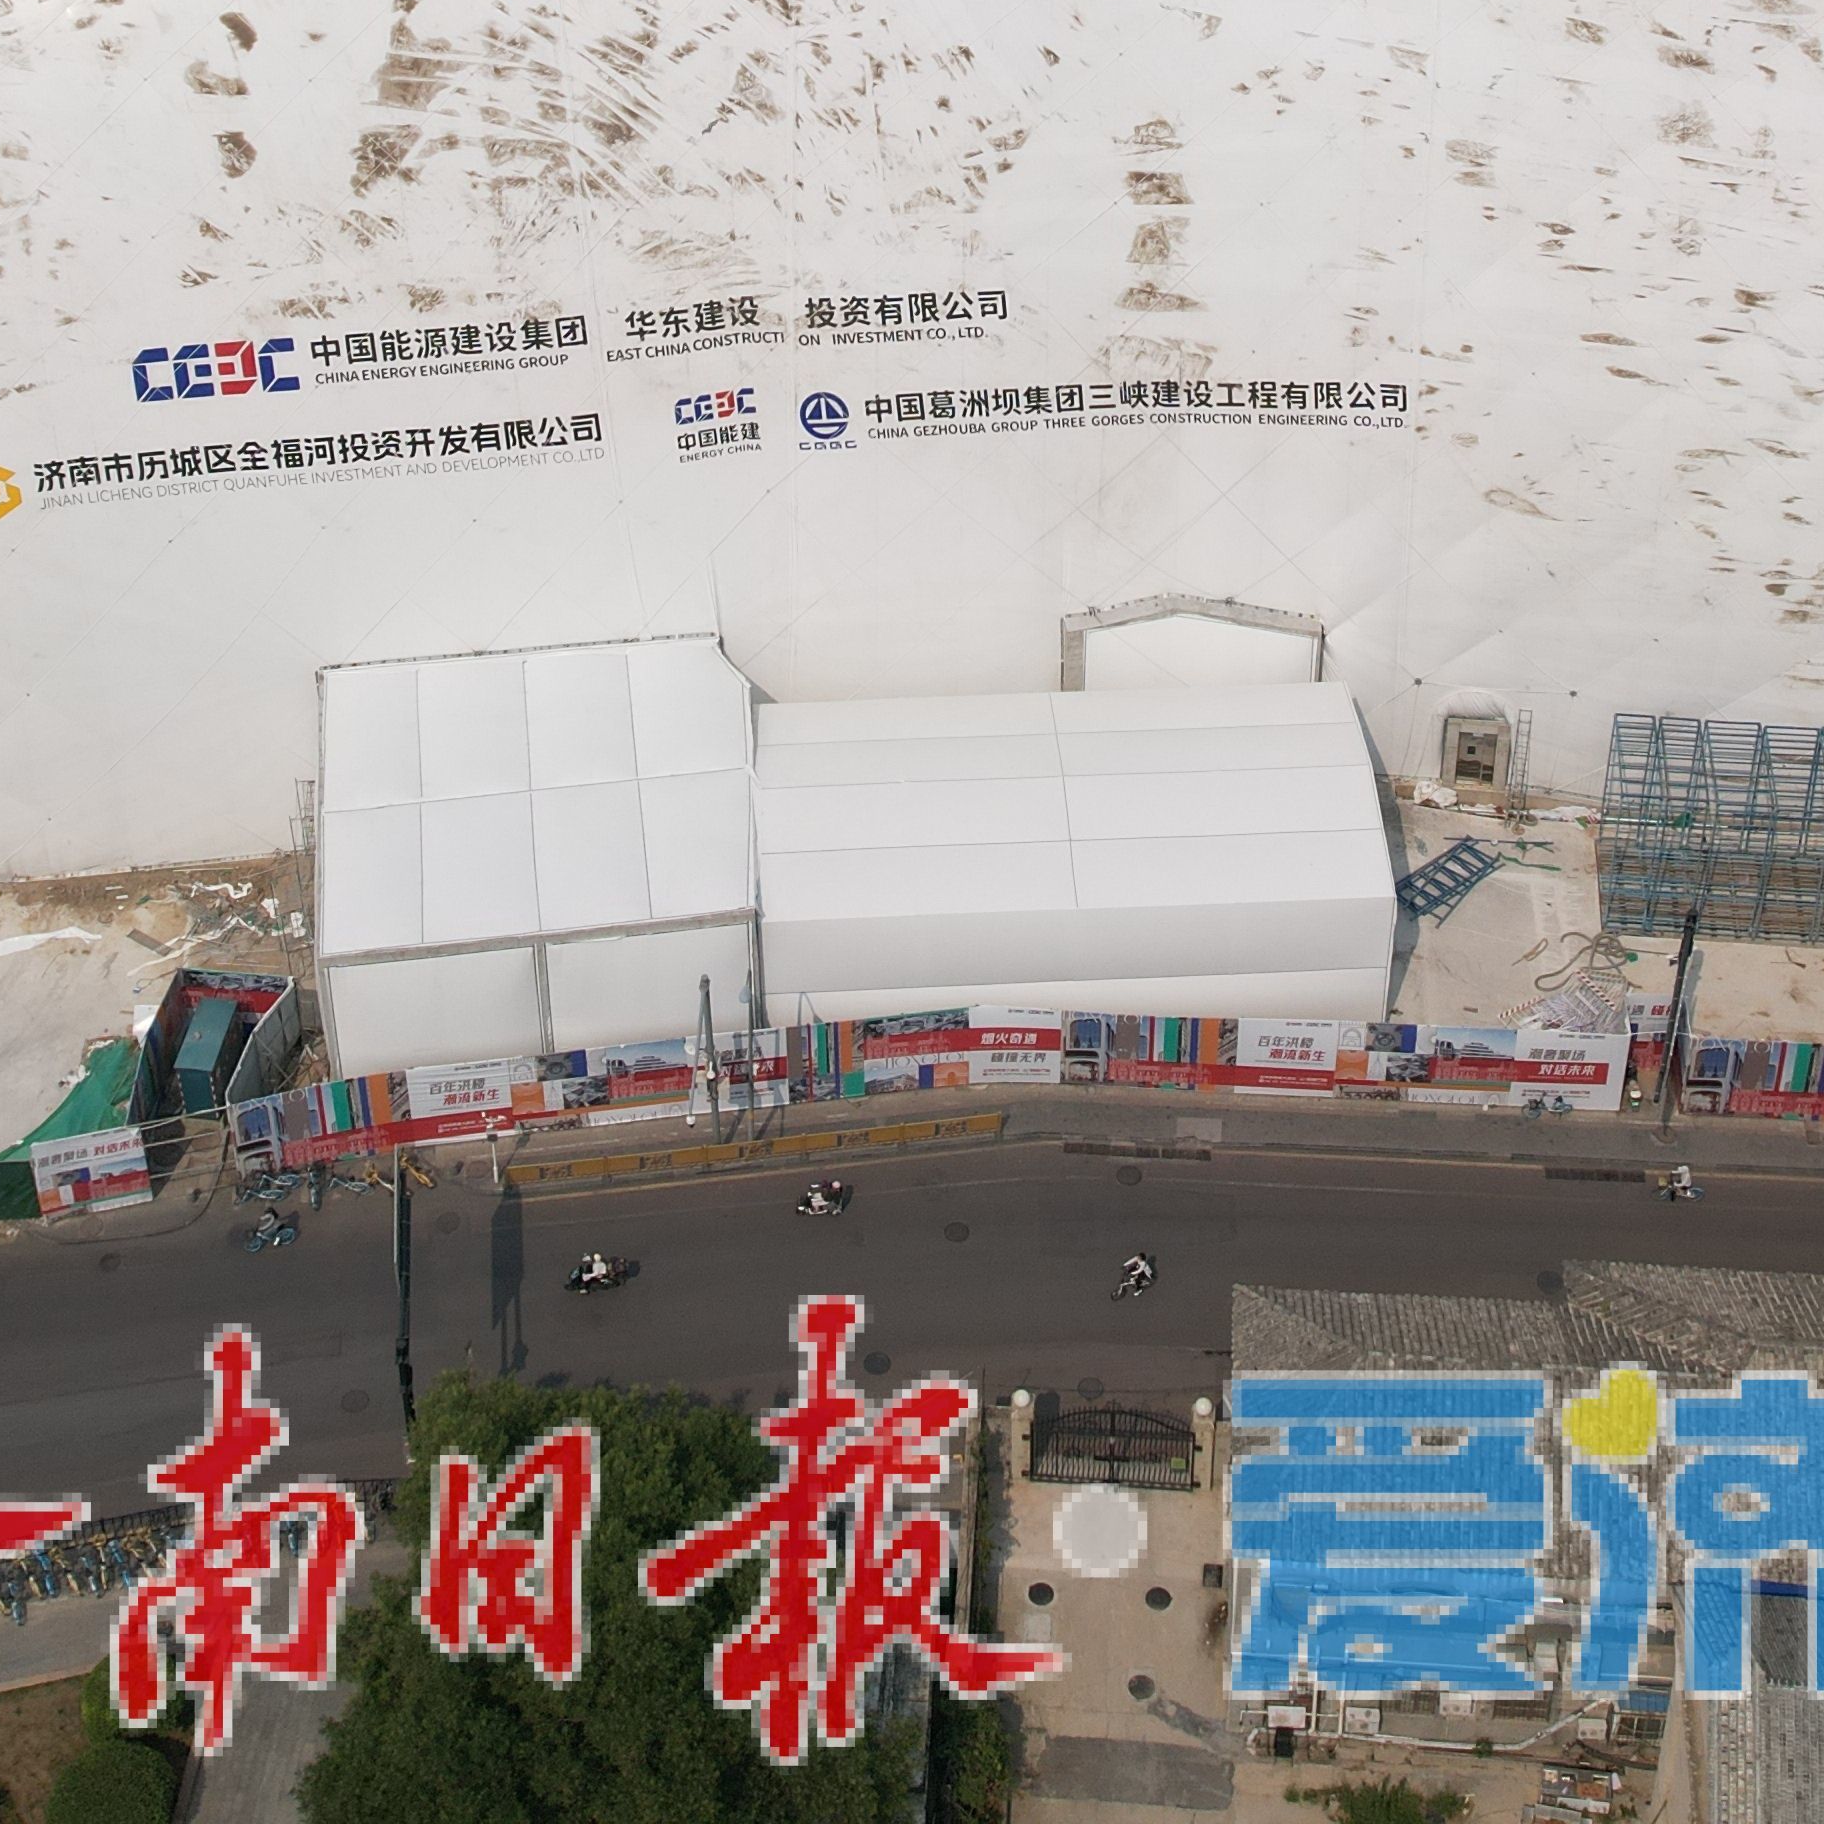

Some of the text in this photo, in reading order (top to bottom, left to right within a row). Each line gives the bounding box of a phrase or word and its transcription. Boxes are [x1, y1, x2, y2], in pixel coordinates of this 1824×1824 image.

[310, 290, 1008, 368] 中国能源建设集团 华东建设 投资有限公司
[606, 347, 642, 363] EAST
[645, 342, 691, 360] CHINA
[831, 328, 924, 346] INVESTMENT
[315, 353, 570, 385] CHINA ENERGY ENGINEERING GROUP
[864, 379, 1408, 424] 中国葛洲坝集团三峡建设工程有限公司
[677, 422, 762, 453] 中国能建
[868, 427, 909, 439] CHINA
[913, 422, 986, 437] GEZHOUBA
[991, 420, 1038, 433] GROUP
[1043, 416, 1086, 429] THREE
[1091, 413, 1145, 427] GORGES
[1149, 412, 1252, 425] CONSTRUCTION
[1258, 414, 1348, 427] ENGINEERING
[33, 413, 603, 493] 济南市历城区全福河投资开发有限公司
[679, 442, 763, 464] ENERGY CHINA
[799, 439, 858, 451] CGGC
[39, 493, 84, 511] JINAN
[88, 485, 153, 505] LICHENG
[156, 479, 219, 498] DISTRICT
[223, 471, 308, 492] QUANFUHE
[312, 464, 402, 485] INVESTMENT
[406, 462, 436, 476] AND
[443, 451, 549, 474] DEVELOPMENT
[1537, 1063, 1596, 1077] 对话未来
